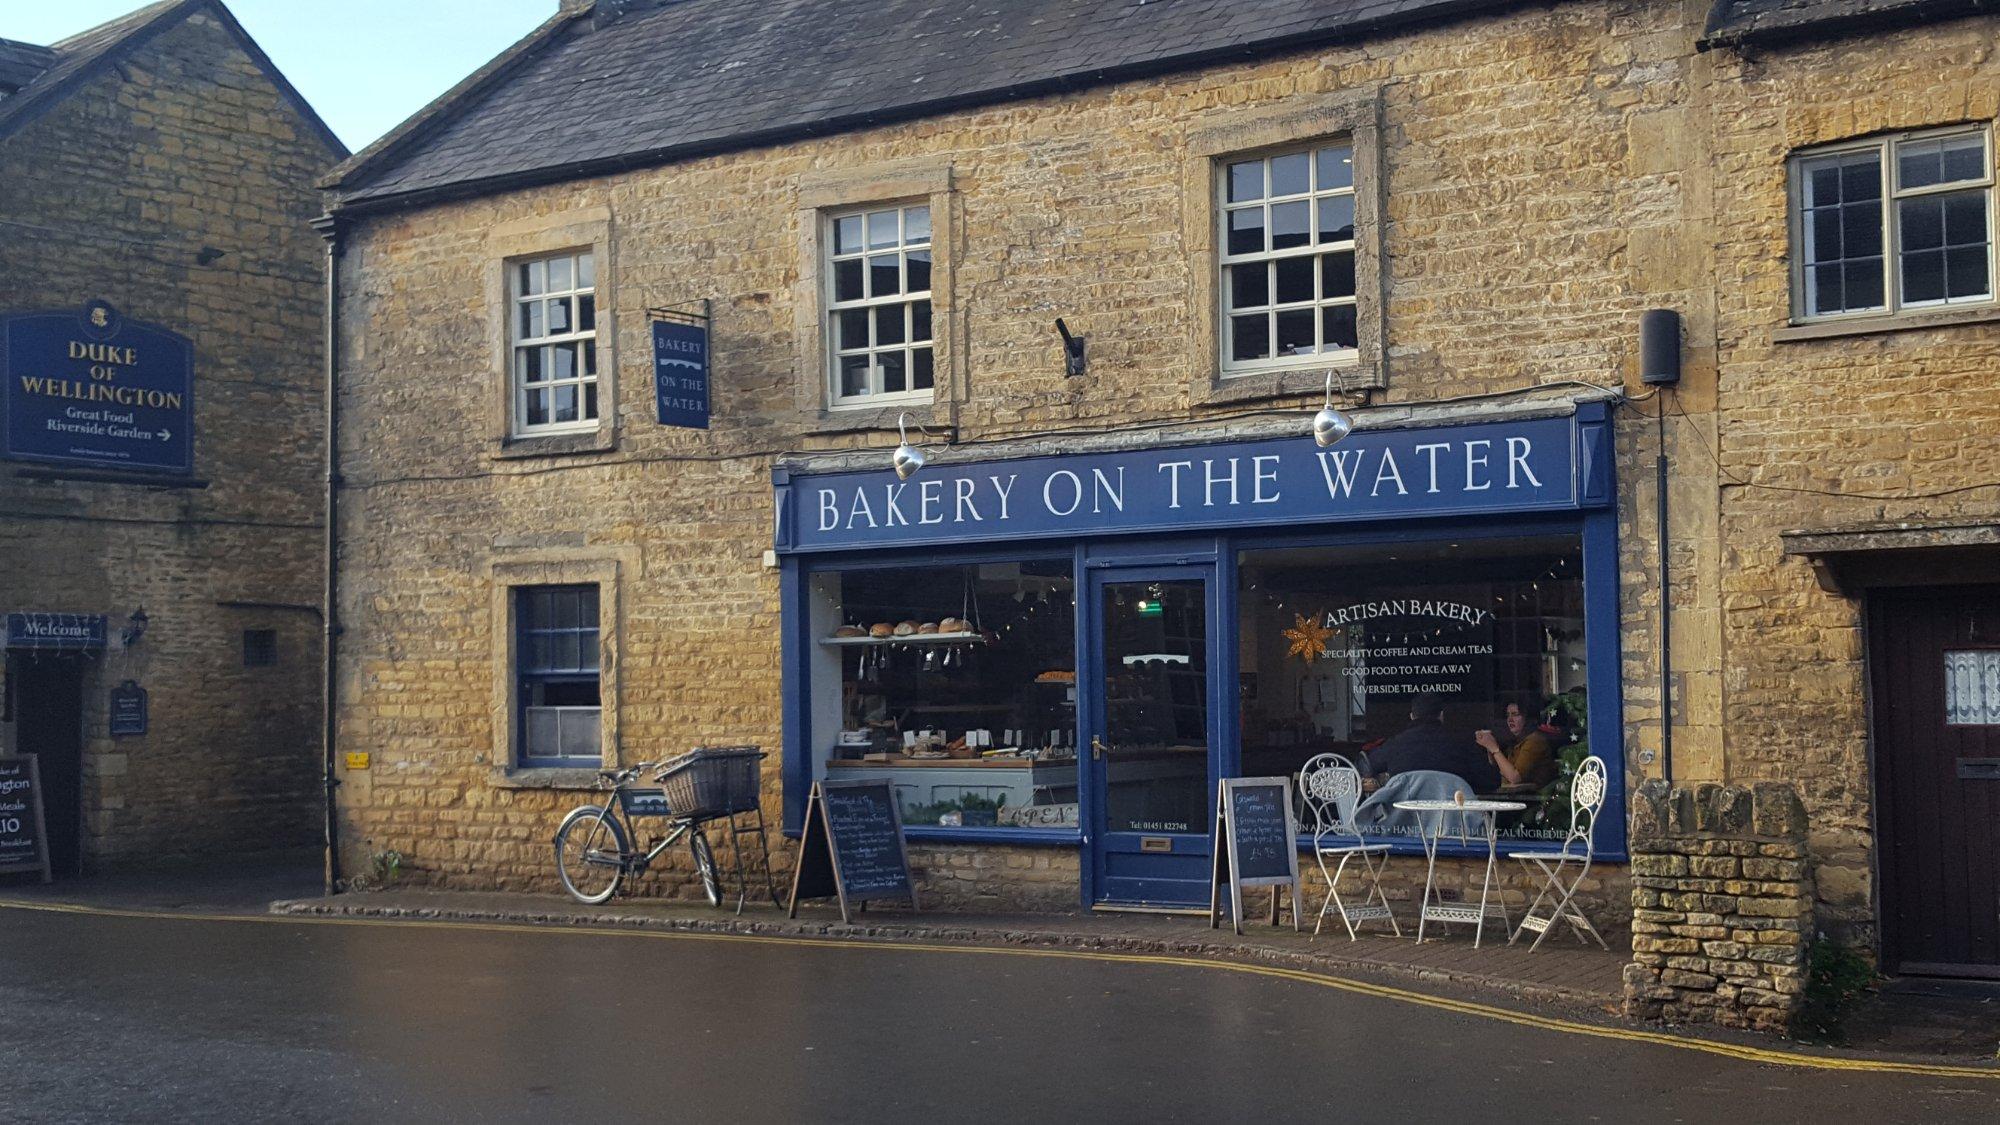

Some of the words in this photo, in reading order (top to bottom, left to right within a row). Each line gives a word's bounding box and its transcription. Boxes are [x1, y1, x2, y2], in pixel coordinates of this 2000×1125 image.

[68, 340, 139, 366] DUKE
[658, 337, 702, 354] BAKERY
[90, 365, 116, 381] OF
[661, 375, 676, 388] ON
[680, 378, 704, 392] THE
[21, 375, 183, 410] WELLINGTON
[662, 396, 704, 412] WATER
[66, 406, 100, 421] Great
[103, 410, 134, 425] Food
[47, 418, 104, 436] Riverside
[107, 425, 152, 441] Garden
[817, 474, 1018, 532] BAKERY
[1043, 466, 1125, 517] ON
[1158, 455, 1281, 509] THE
[1316, 436, 1543, 500] WATER
[1325, 600, 1406, 628] ARTISAN
[1410, 599, 1487, 625] BAKERY
[25, 622, 91, 636] Welcome
[1321, 649, 1372, 659] SPECIALITY
[1373, 647, 1408, 657] COFFEE
[1409, 646, 1431, 656] AND
[1432, 645, 1467, 655] CREAM
[1467, 644, 1493, 654] TEAS
[1341, 667, 1370, 677] GOOD
[1371, 666, 1398, 676] FOOD
[1398, 665, 1413, 675] TO
[1414, 665, 1440, 675] TAKE
[1440, 664, 1472, 674] AWAY
[1353, 685, 1401, 695] RIVERSIDE
[1400, 684, 1420, 694] TEA
[1421, 683, 1462, 693] GARDEN
[1011, 807, 1073, 826] OPEN
[1143, 821, 1162, 830] 01451
[1482, 827, 1516, 838] LCAL
